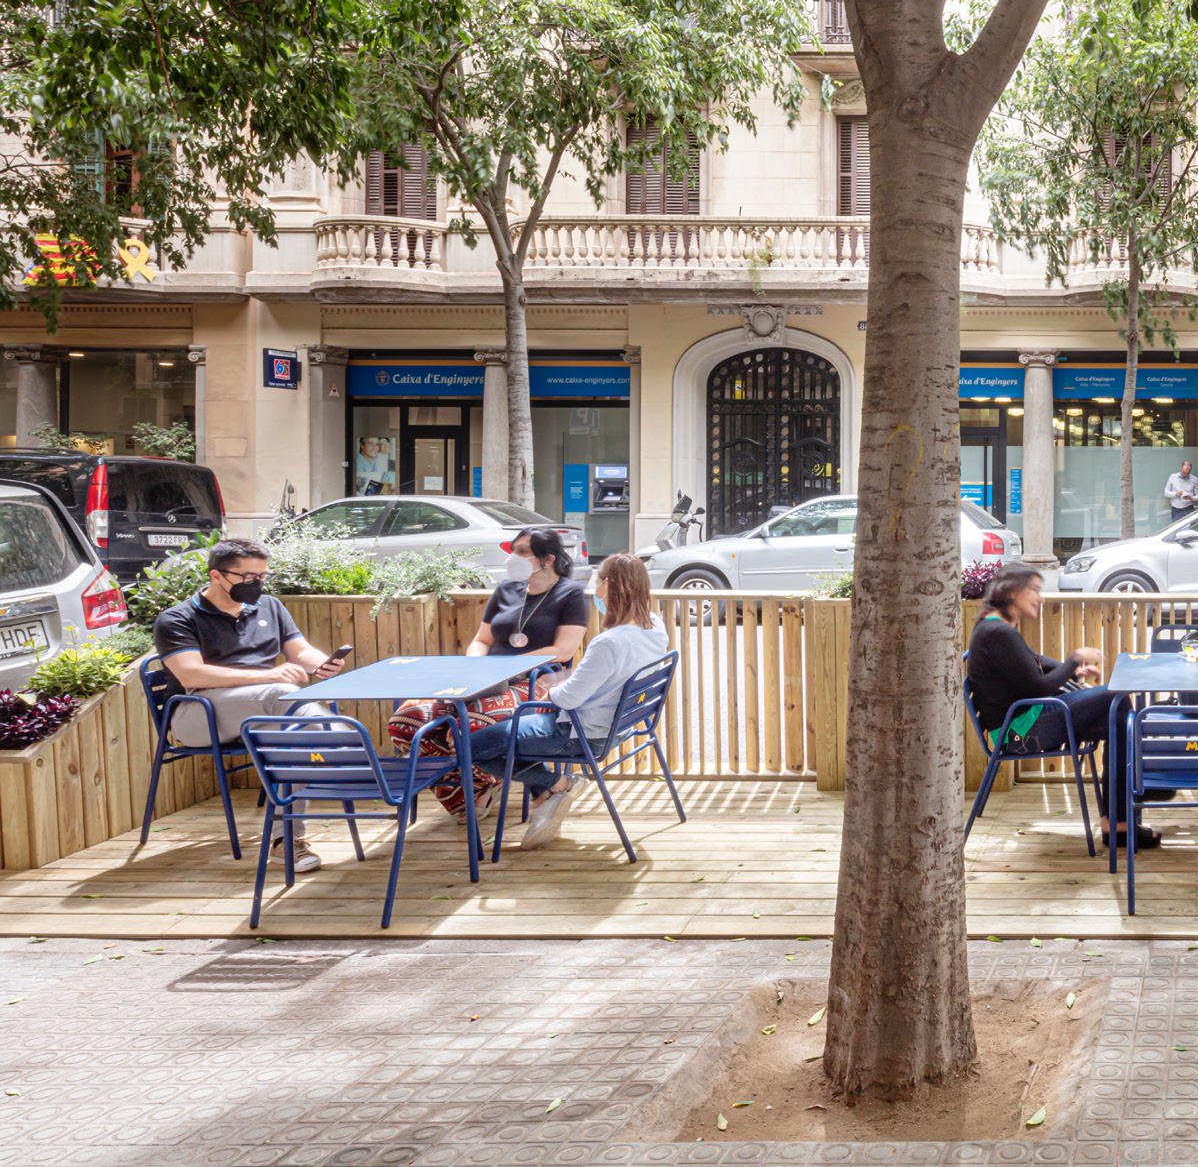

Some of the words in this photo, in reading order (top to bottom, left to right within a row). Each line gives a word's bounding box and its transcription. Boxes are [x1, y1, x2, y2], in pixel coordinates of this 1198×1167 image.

[392, 374, 421, 384] Caixa
[424, 374, 484, 386] d'Enginyers
[973, 377, 1018, 386] d'Enginyers
[154, 535, 173, 544] 3722
[1185, 741, 1198, 751] M
[310, 752, 325, 762] M
